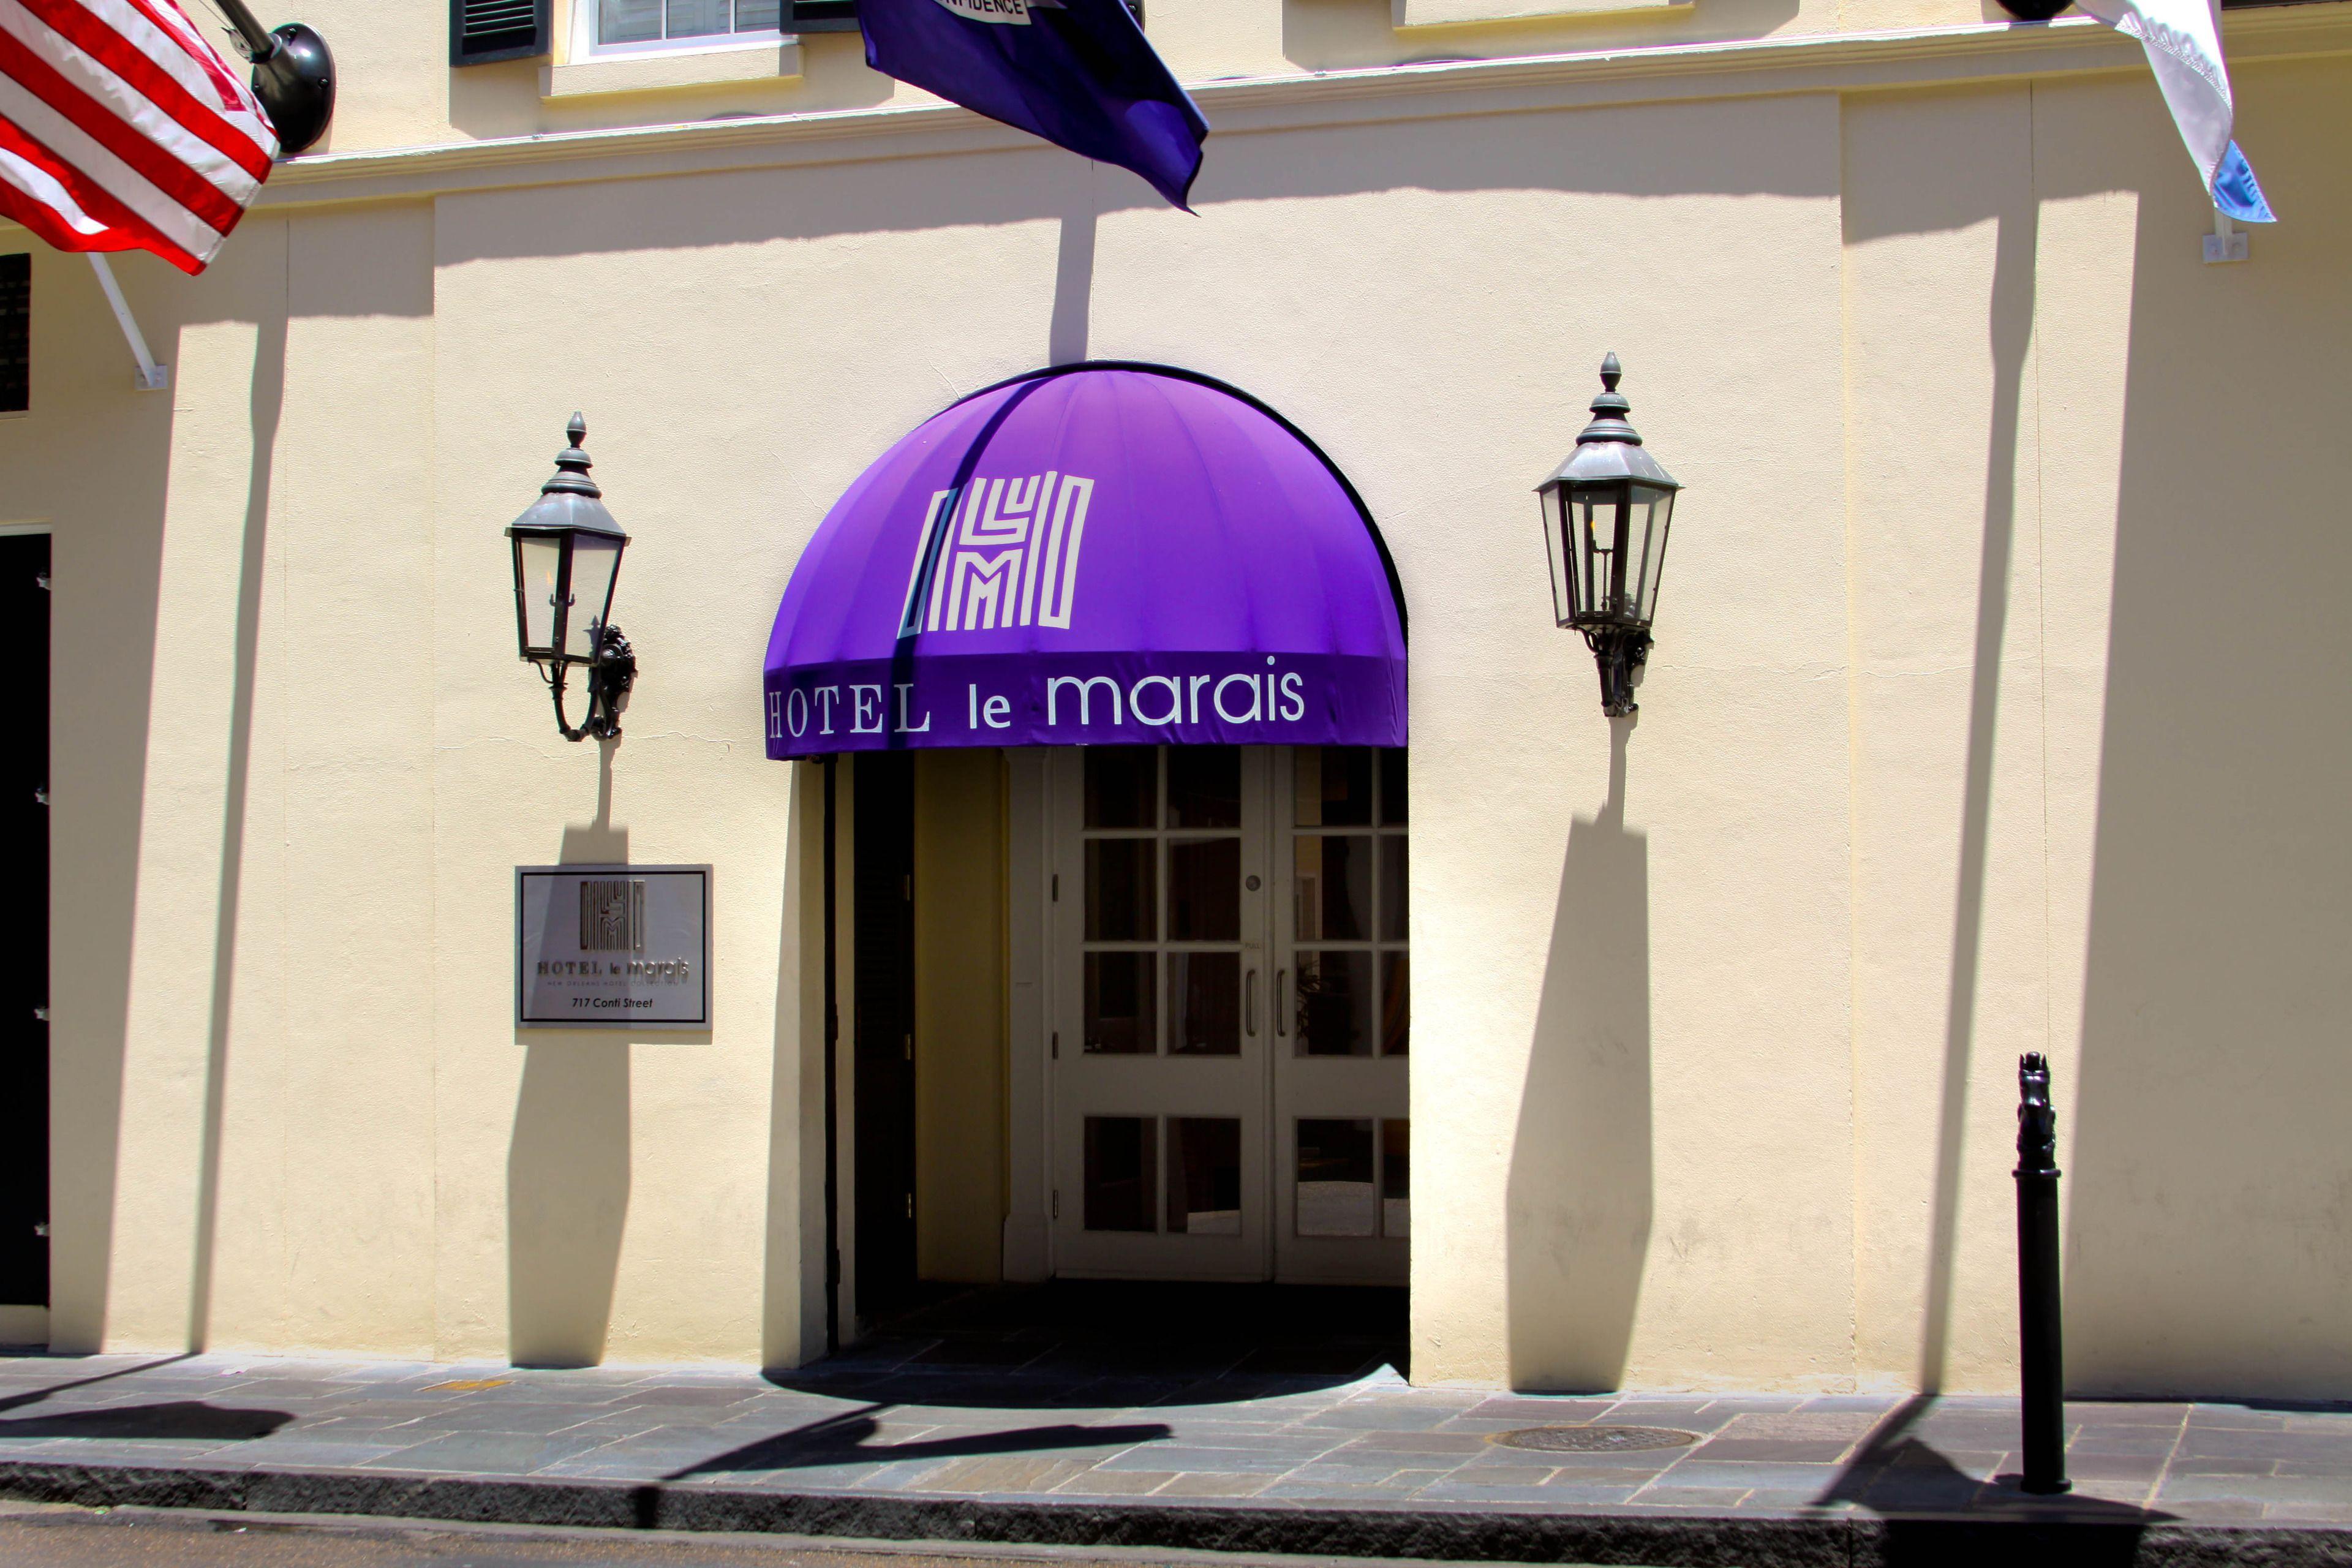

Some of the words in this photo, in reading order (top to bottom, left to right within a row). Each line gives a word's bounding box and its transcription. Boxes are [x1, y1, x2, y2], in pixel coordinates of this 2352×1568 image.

[769, 683, 930, 739] HOTEL
[970, 684, 1011, 729] le
[1047, 655, 1305, 726] marais
[537, 960, 601, 975] HOTEL
[610, 962, 621, 974] le
[627, 956, 689, 975] marais
[572, 998, 590, 1008] 717
[593, 998, 620, 1008] Conti
[623, 998, 653, 1008] Street
